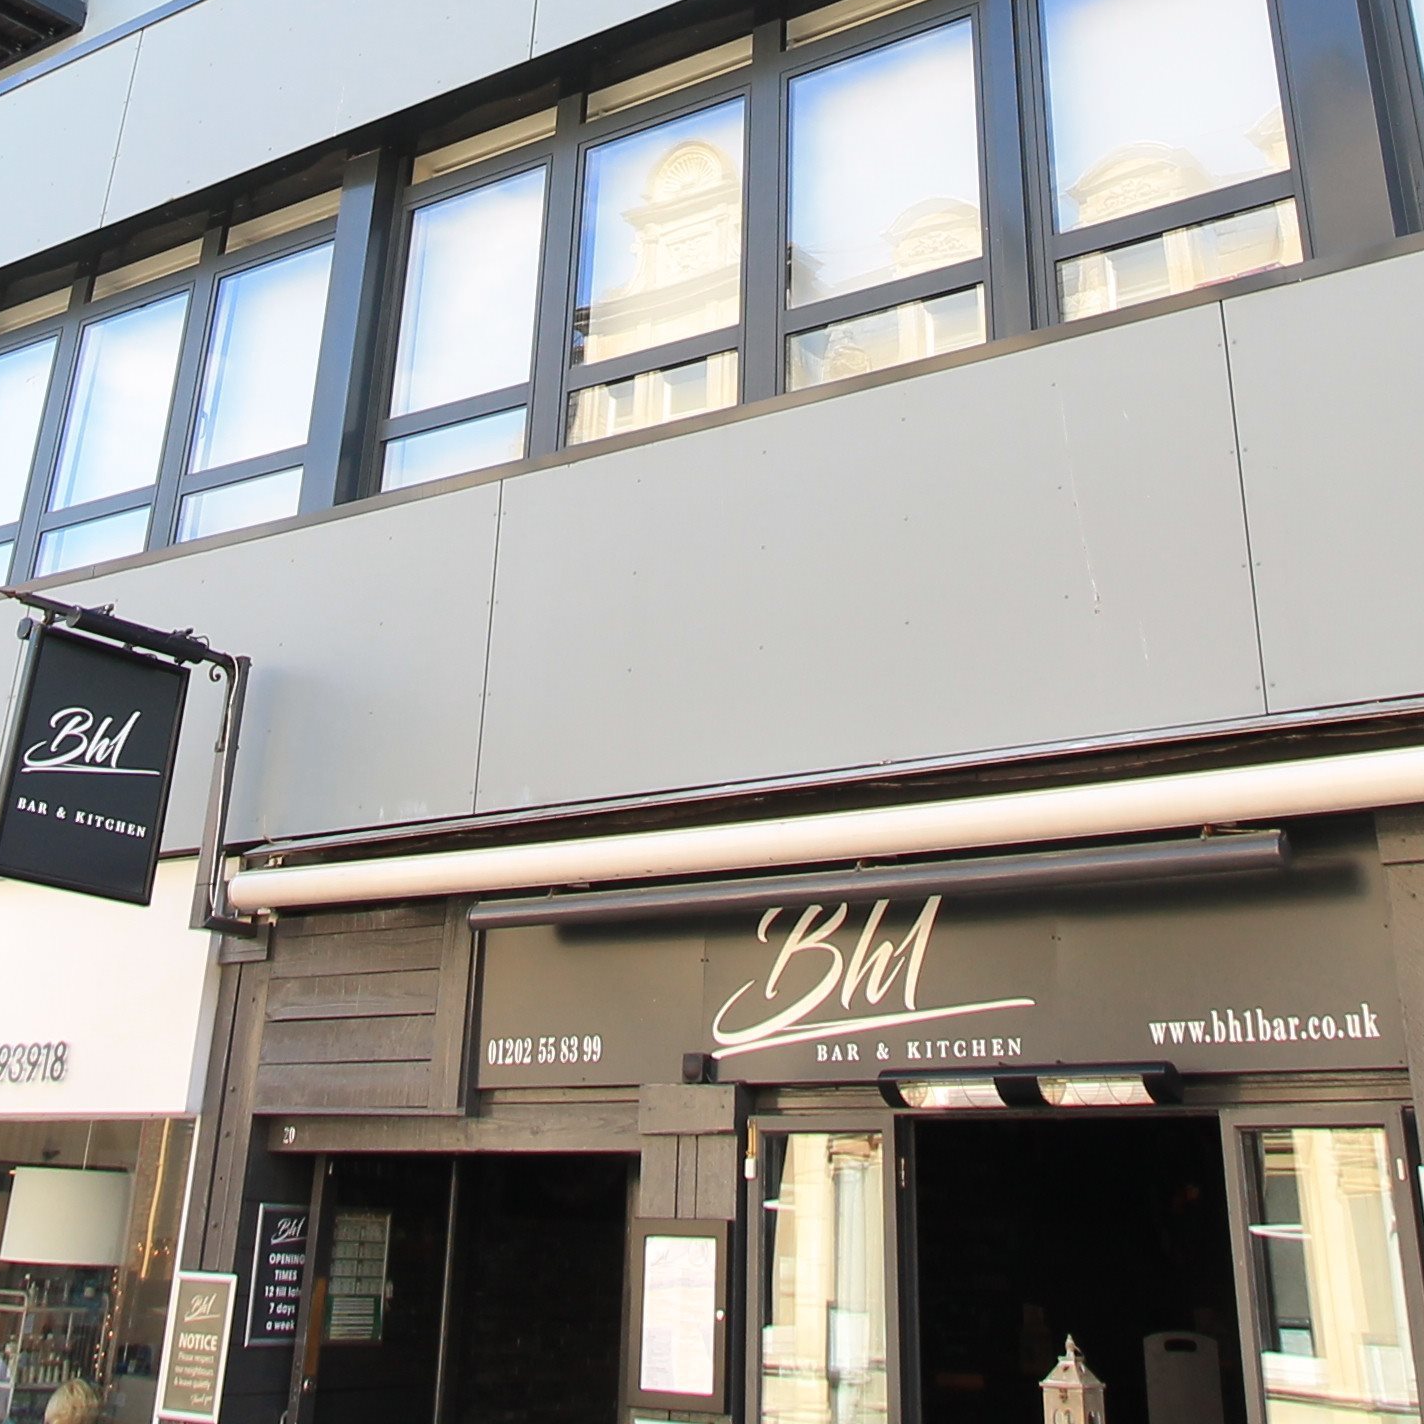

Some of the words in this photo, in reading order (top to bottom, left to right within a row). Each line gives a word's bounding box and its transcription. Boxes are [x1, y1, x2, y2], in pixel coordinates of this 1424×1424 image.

[17, 797, 48, 816] BAR
[56, 806, 67, 820] &
[75, 811, 147, 839] KITCHEN
[1148, 1003, 1381, 1045] www.bh1bar.co.uk
[487, 1037, 533, 1065] 01202
[537, 1037, 556, 1064] 55
[559, 1036, 579, 1063] 83
[583, 1035, 602, 1062] 99
[816, 1043, 861, 1062] BAR
[876, 1042, 891, 1060] &
[907, 1037, 1023, 1059] KITCHEN
[282, 1126, 296, 1144] 20
[269, 1253, 306, 1265] OPENING
[274, 1269, 297, 1281] TIMES
[264, 1285, 274, 1297] 12
[268, 1302, 275, 1314] 7
[276, 1302, 295, 1316] days
[266, 1320, 273, 1331] a
[274, 1320, 295, 1331] week
[178, 1332, 218, 1351] NOTICE
